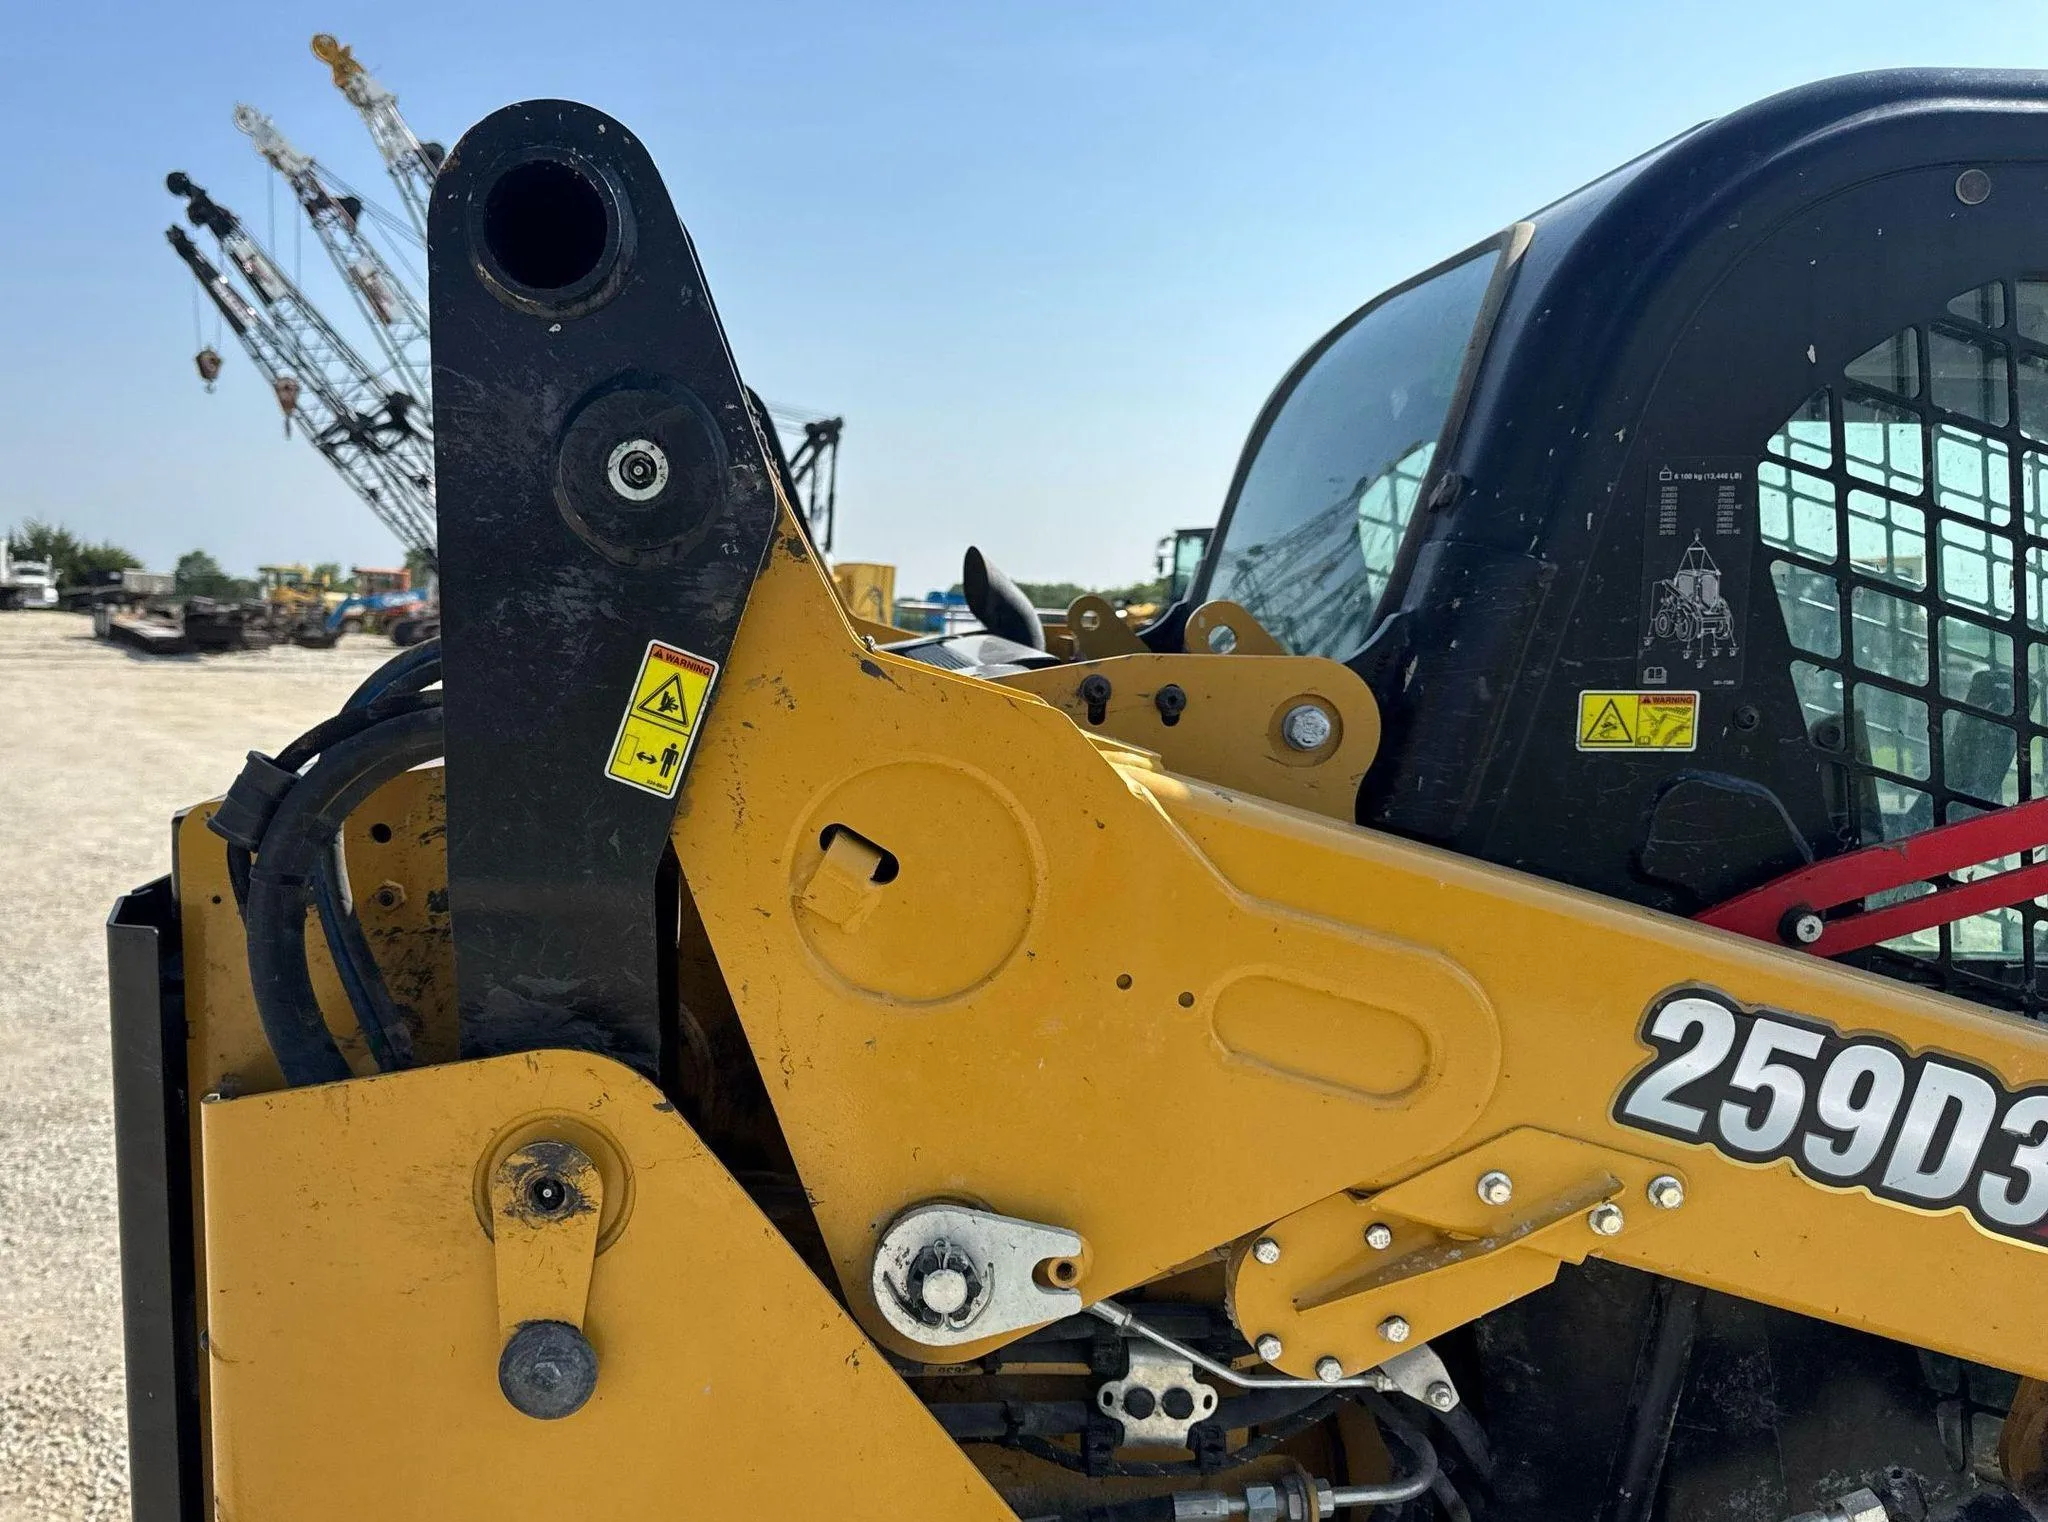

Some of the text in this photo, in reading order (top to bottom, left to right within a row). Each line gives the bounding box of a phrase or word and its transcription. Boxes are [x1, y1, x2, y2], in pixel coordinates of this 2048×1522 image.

[1694, 473, 1702, 481] kg
[665, 652, 711, 676] WARNING
[1652, 696, 1693, 704] WARNING
[1624, 997, 2048, 1227] 259D3
